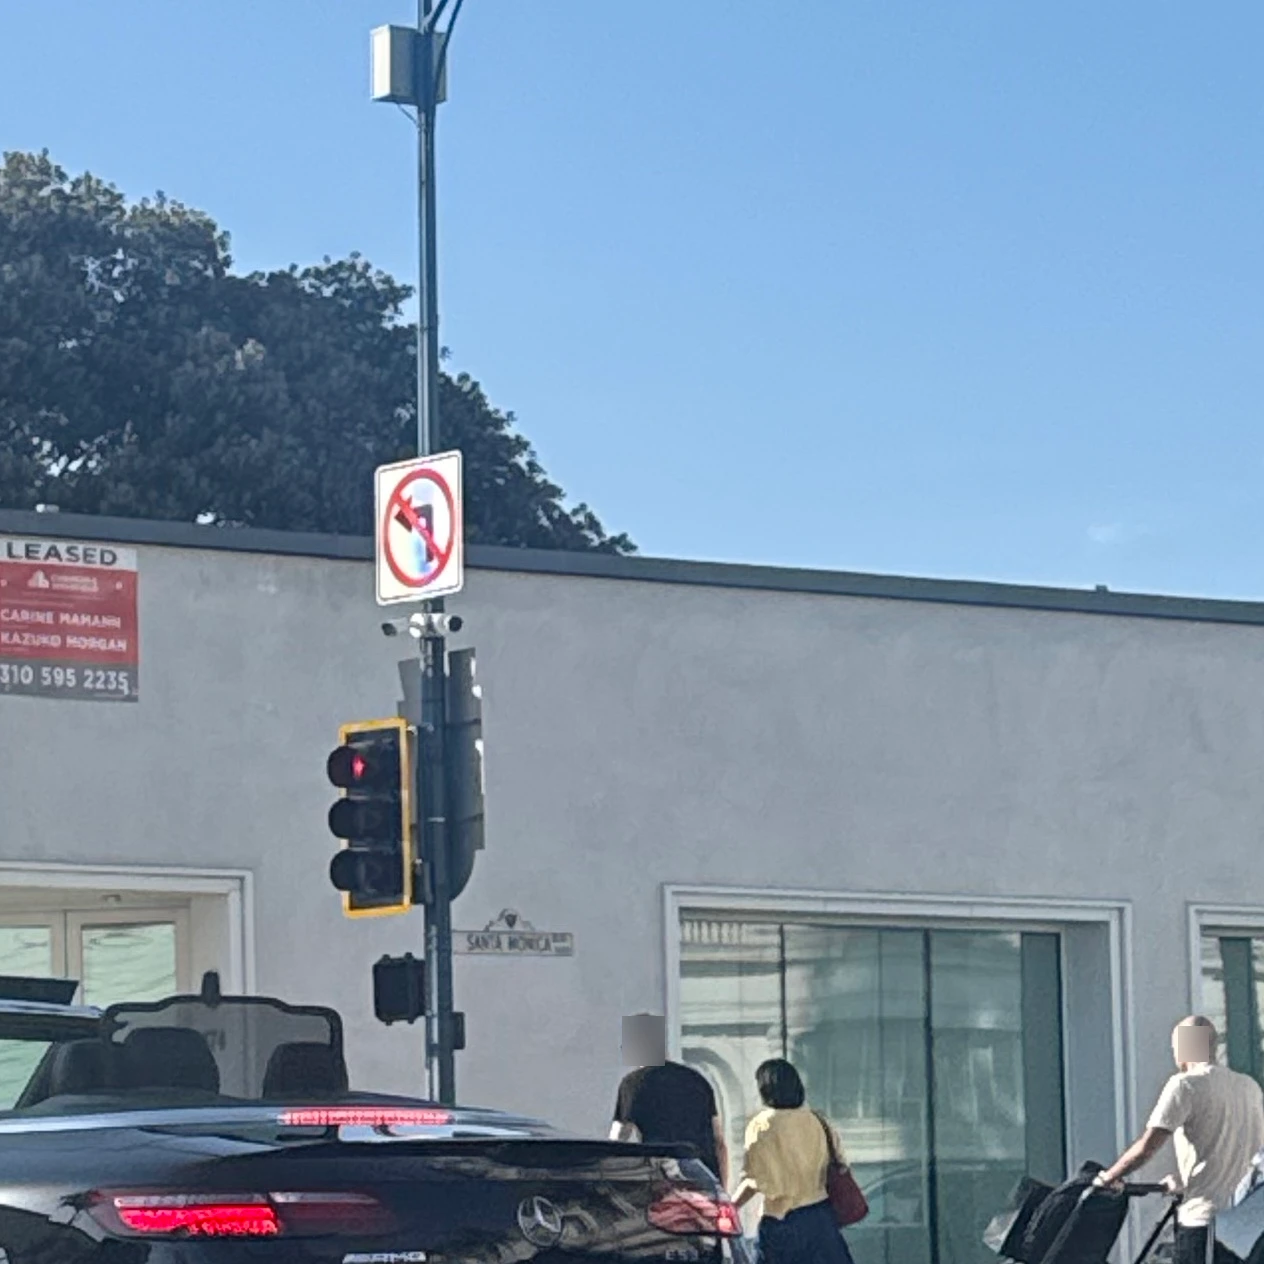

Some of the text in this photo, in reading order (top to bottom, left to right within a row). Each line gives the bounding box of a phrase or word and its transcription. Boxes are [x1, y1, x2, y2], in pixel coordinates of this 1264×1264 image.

[5, 541, 118, 566] LEASED
[66, 634, 128, 652] MORGAN
[40, 666, 77, 688] 595
[83, 668, 129, 692] 2235
[467, 932, 502, 951] SANTA
